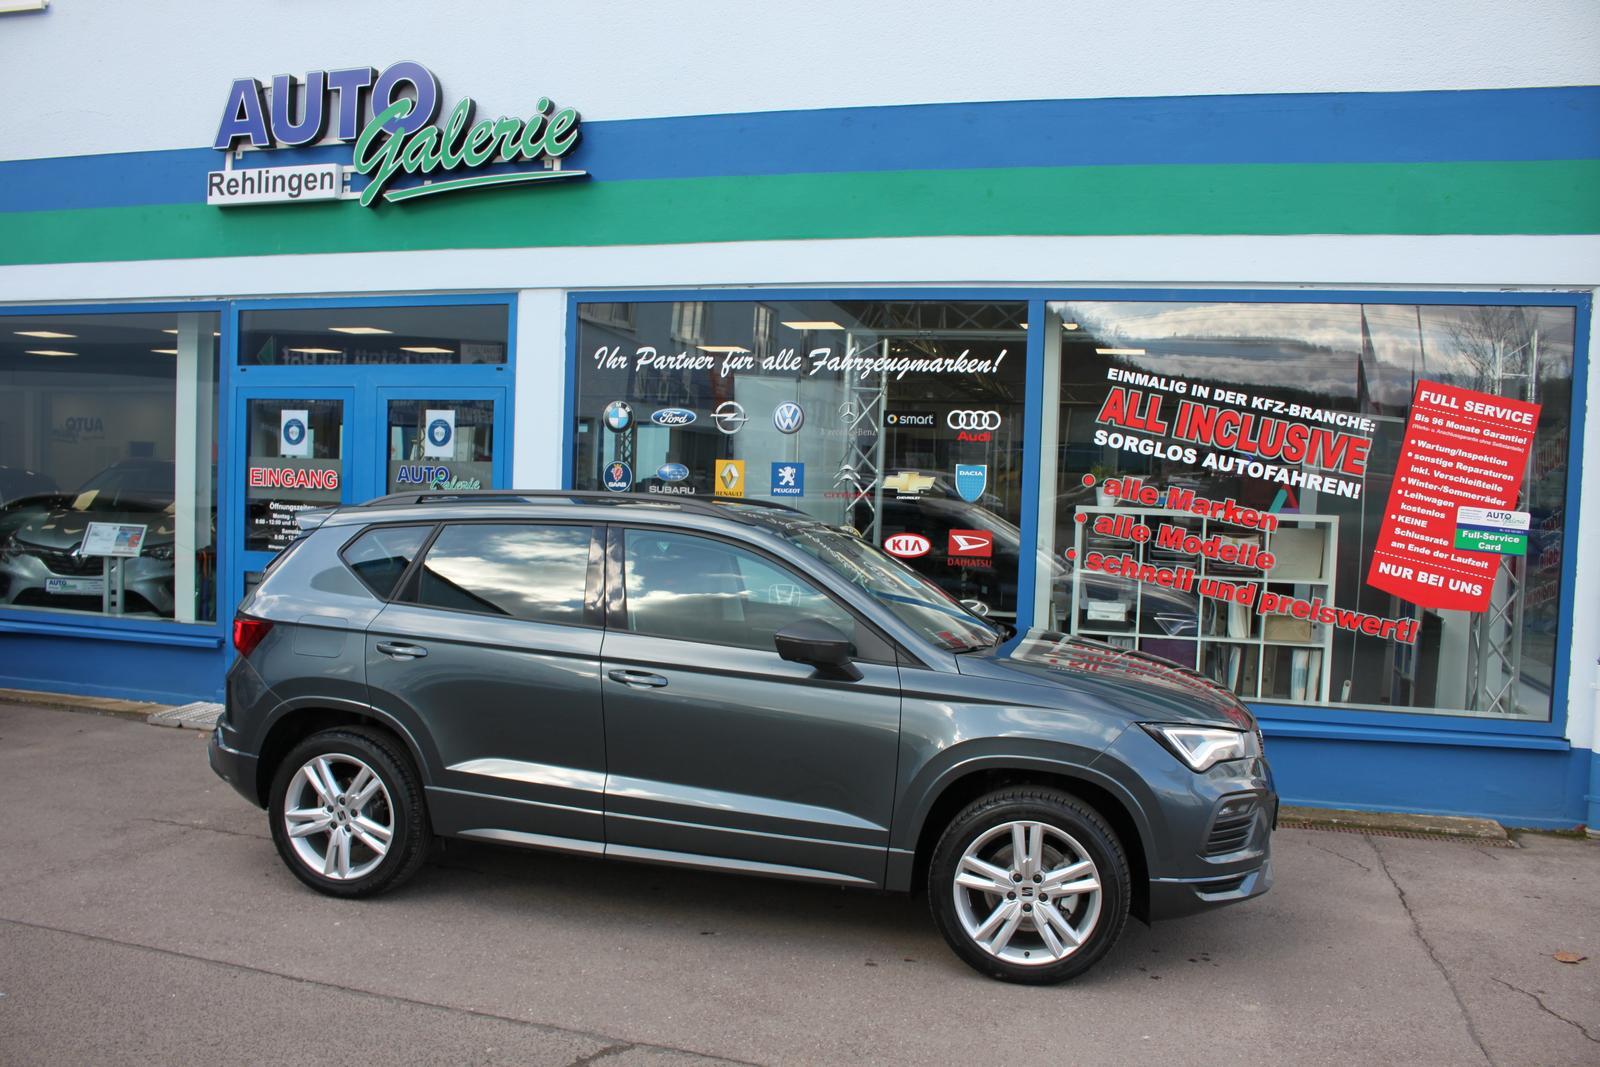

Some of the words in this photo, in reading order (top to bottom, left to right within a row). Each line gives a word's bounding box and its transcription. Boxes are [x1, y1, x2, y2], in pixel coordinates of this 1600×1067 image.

[212, 61, 437, 149] AUTO
[353, 97, 578, 207] Galerie
[208, 170, 334, 199] Rehlingen
[593, 346, 628, 371] Ihr
[635, 346, 716, 371] Partner
[720, 350, 756, 378] für
[762, 348, 801, 371] alle
[808, 349, 1008, 381] Fahrzeugmarken!
[1107, 367, 1187, 394] EINMALIG
[1191, 384, 1210, 399] IN
[1213, 388, 1248, 407] DER
[1251, 396, 1376, 432] KFZ-BRANCHE:
[1419, 390, 1460, 409] FULL
[1463, 400, 1534, 425] SERVICE
[658, 409, 688, 424] Ford
[899, 414, 933, 425] smart
[1414, 413, 1430, 424] Bis
[1431, 416, 1444, 426] 96
[1445, 419, 1481, 435] Monate
[1482, 428, 1527, 445] Garantie!
[956, 431, 992, 442] Audi
[1096, 386, 1169, 437] ALL
[1171, 400, 1373, 478] INCLUSIVE
[1093, 429, 1198, 464] SORGLOS
[1201, 452, 1362, 499] AUTOFAHREN!
[1417, 440, 1508, 467] Wartung/Inspektion
[249, 467, 338, 490] EINGANG
[396, 465, 450, 484] AUTO
[1410, 465, 1431, 476] inkl.
[1433, 470, 1503, 493] Verschleißteile
[1414, 453, 1454, 468] sonstige
[1455, 462, 1514, 482] Reparaturen
[430, 475, 481, 490] Galerie
[649, 485, 696, 495] SUBARU
[1407, 477, 1508, 507] Winter-/Sommerräder
[1103, 475, 1160, 507] alle
[1164, 485, 1280, 533] Marken
[1400, 502, 1446, 519] kostenlos
[1404, 490, 1455, 508] Leihwagen
[1397, 515, 1429, 528] KEINE
[1486, 511, 1512, 520] AUTO
[891, 539, 923, 552] KIA
[1093, 513, 1151, 544] alle
[1156, 524, 1276, 570] Modelle
[1394, 527, 1449, 547] Schlussrate
[1462, 531, 1520, 544] Full-Service
[1478, 543, 1501, 551] Card
[947, 558, 993, 568] DAIHATSU
[1390, 541, 1406, 549] am
[1407, 544, 1431, 556] Ende
[1432, 547, 1449, 560] der
[1450, 553, 1489, 570] Laufzeit
[1378, 562, 1414, 581] NUR
[1416, 572, 1445, 588] BEI
[1448, 578, 1483, 597] UNS
[1085, 550, 1196, 593] schnell
[1198, 576, 1258, 607] und
[1257, 589, 1421, 645] preiswert!
